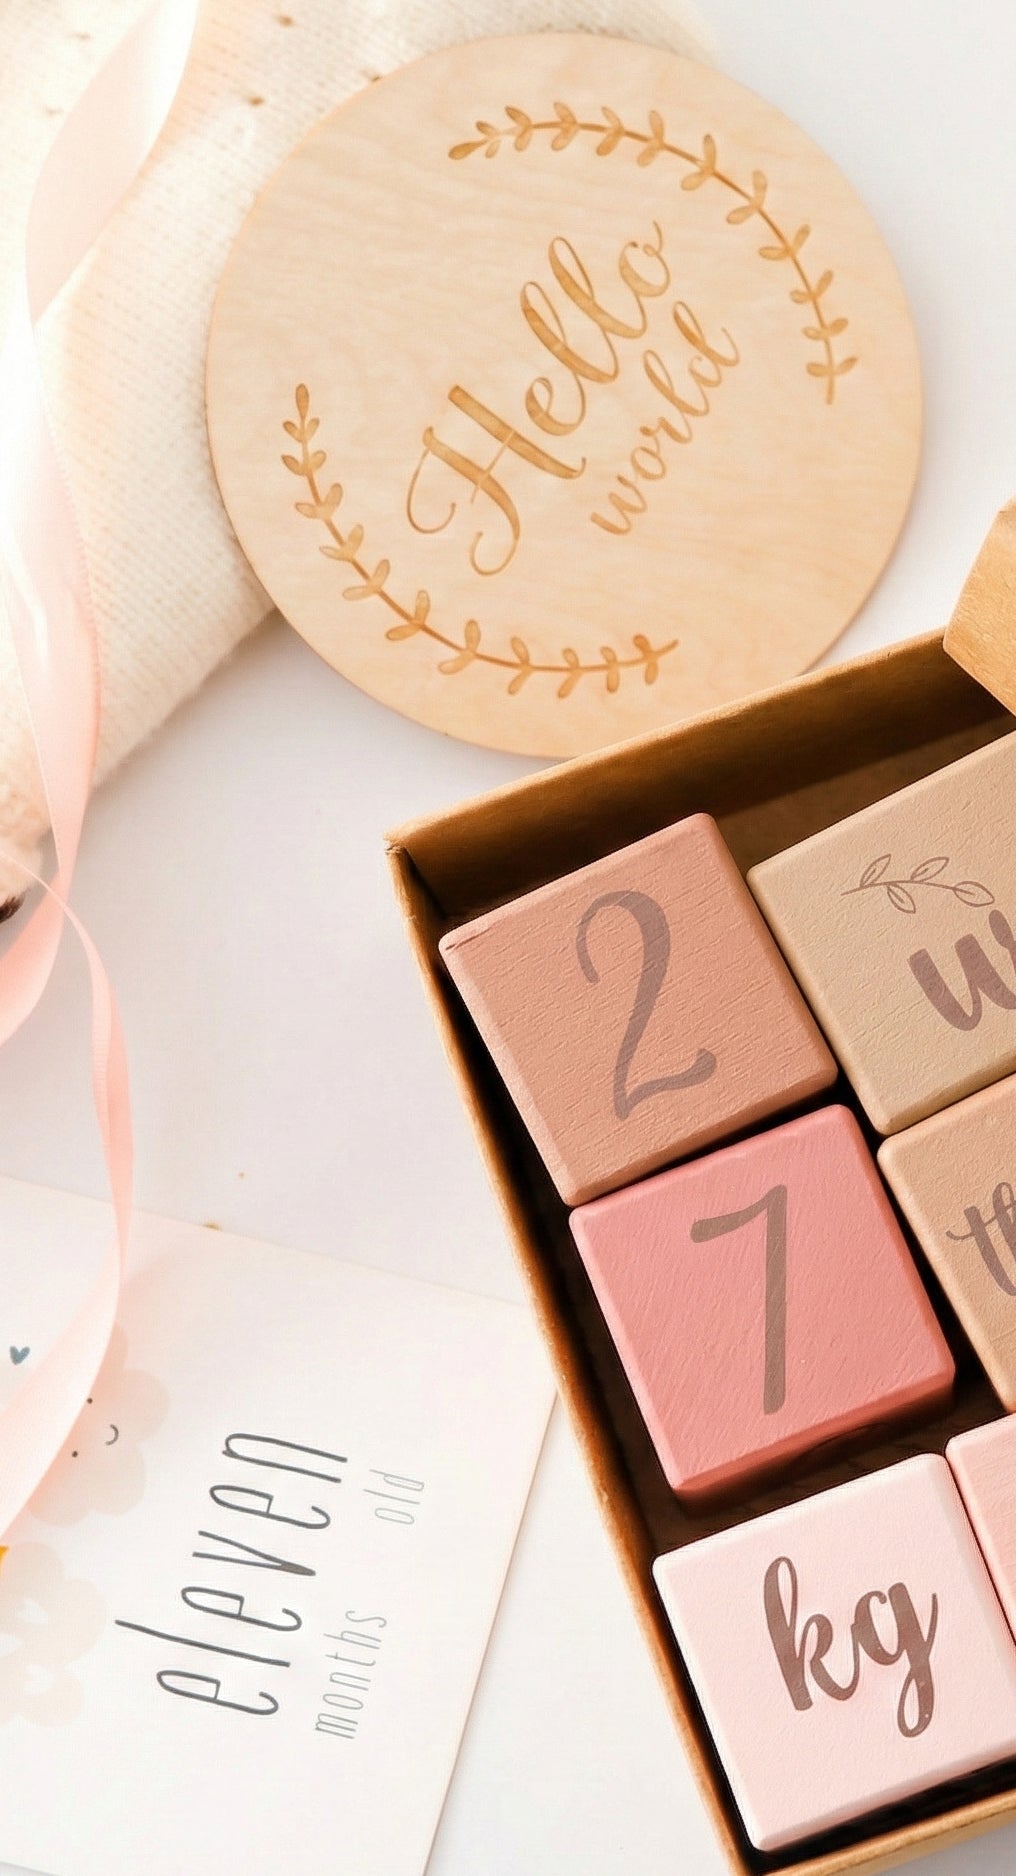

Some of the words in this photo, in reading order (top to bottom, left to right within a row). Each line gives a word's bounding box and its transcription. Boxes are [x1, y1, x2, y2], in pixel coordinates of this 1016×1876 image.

[406, 220, 671, 575] Hello
[590, 301, 740, 536] world
[575, 889, 718, 1122] 2
[690, 1184, 788, 1416] 7
[115, 1432, 348, 1716] eleven
[314, 1609, 388, 1740] months
[362, 1469, 425, 1526] old
[763, 1556, 938, 1738] kg
